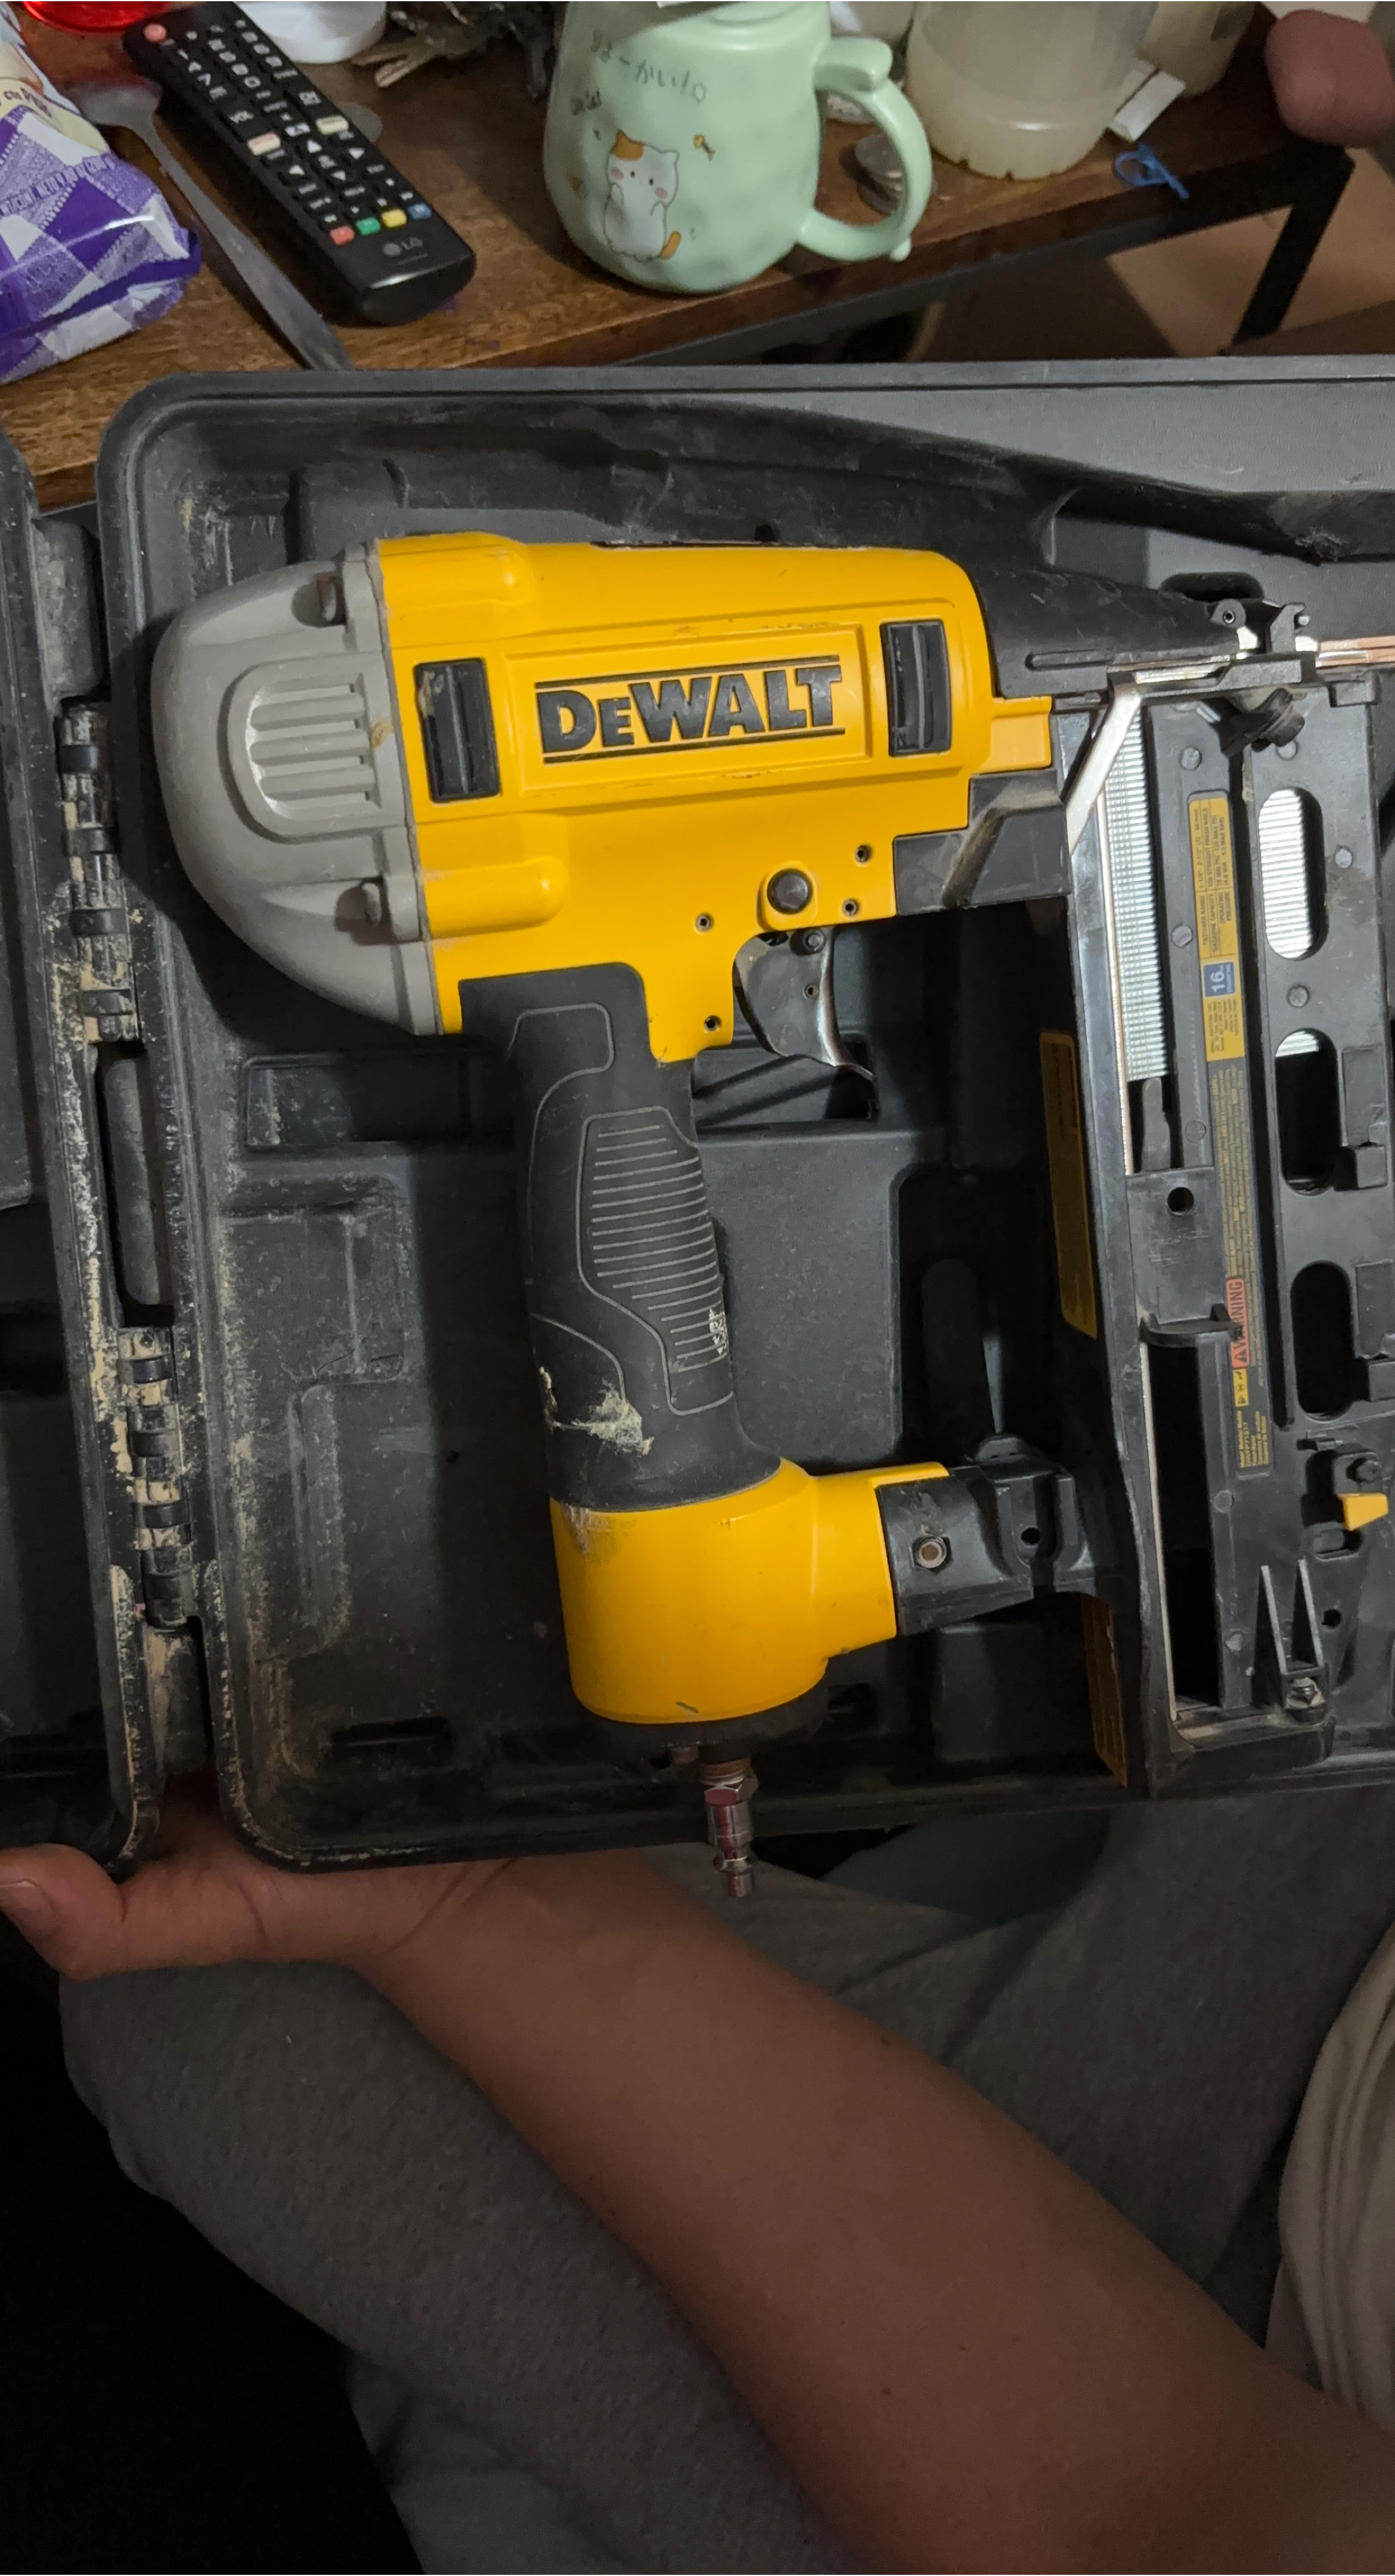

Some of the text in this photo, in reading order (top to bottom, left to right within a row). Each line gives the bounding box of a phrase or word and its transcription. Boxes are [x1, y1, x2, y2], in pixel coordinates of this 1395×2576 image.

[401, 237, 423, 250] LG
[1210, 971, 1225, 992] 16
[1228, 1281, 1246, 1349] WRNING
